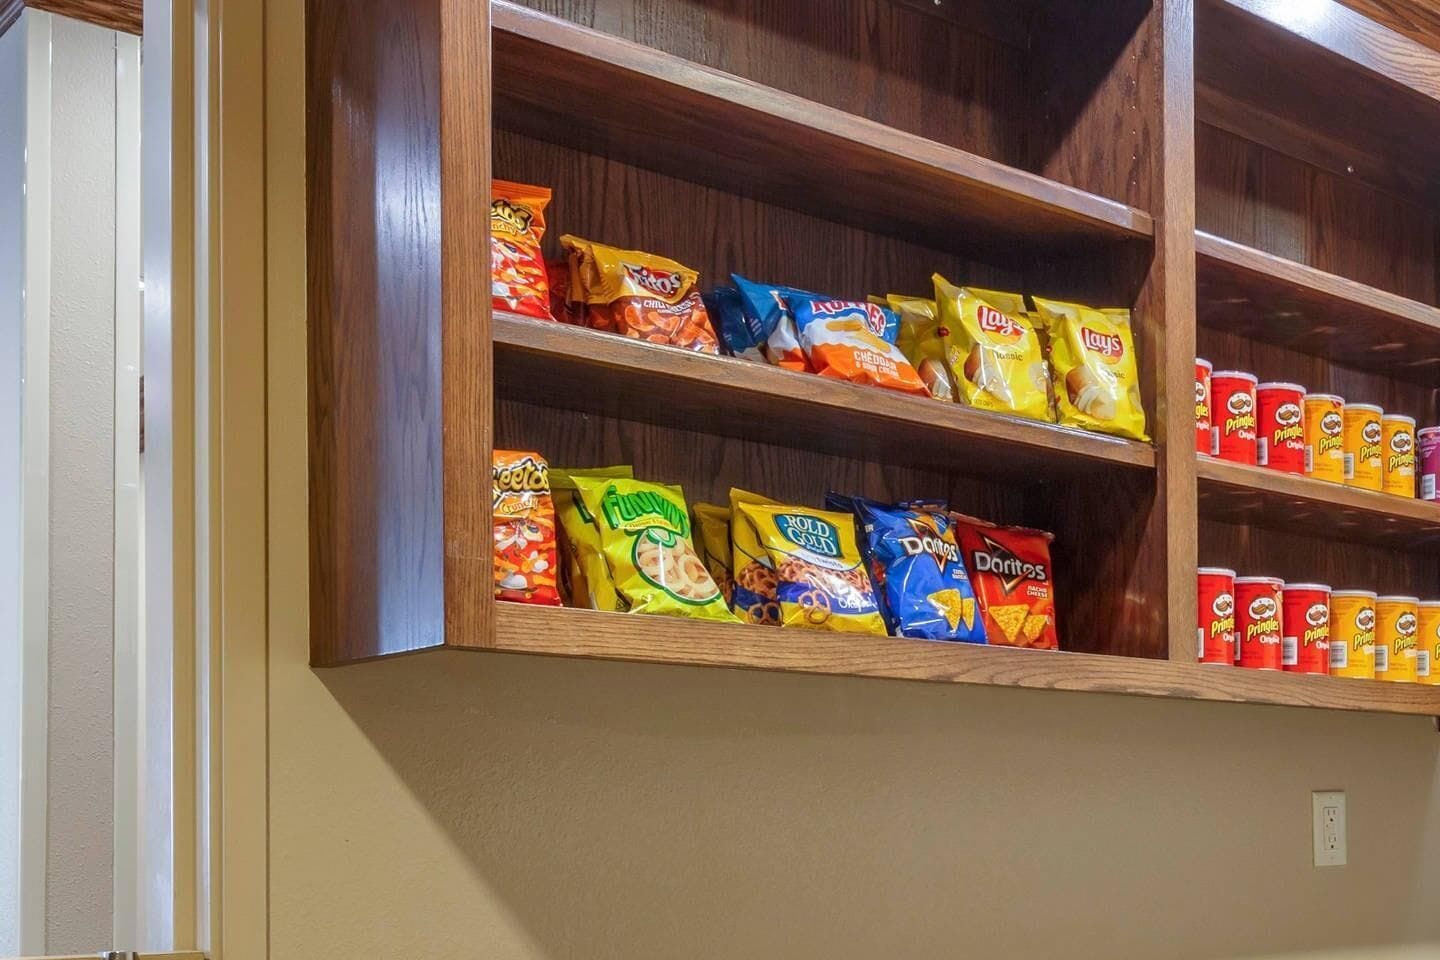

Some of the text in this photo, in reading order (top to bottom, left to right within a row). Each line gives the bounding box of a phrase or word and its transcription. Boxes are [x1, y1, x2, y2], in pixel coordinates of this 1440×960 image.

[493, 459, 550, 491] eetos
[785, 515, 830, 538] ROLD
[786, 527, 837, 556] GOLD
[899, 536, 958, 562] Doritos
[975, 551, 1046, 580] Doritos
[1247, 617, 1280, 642] Pringles
